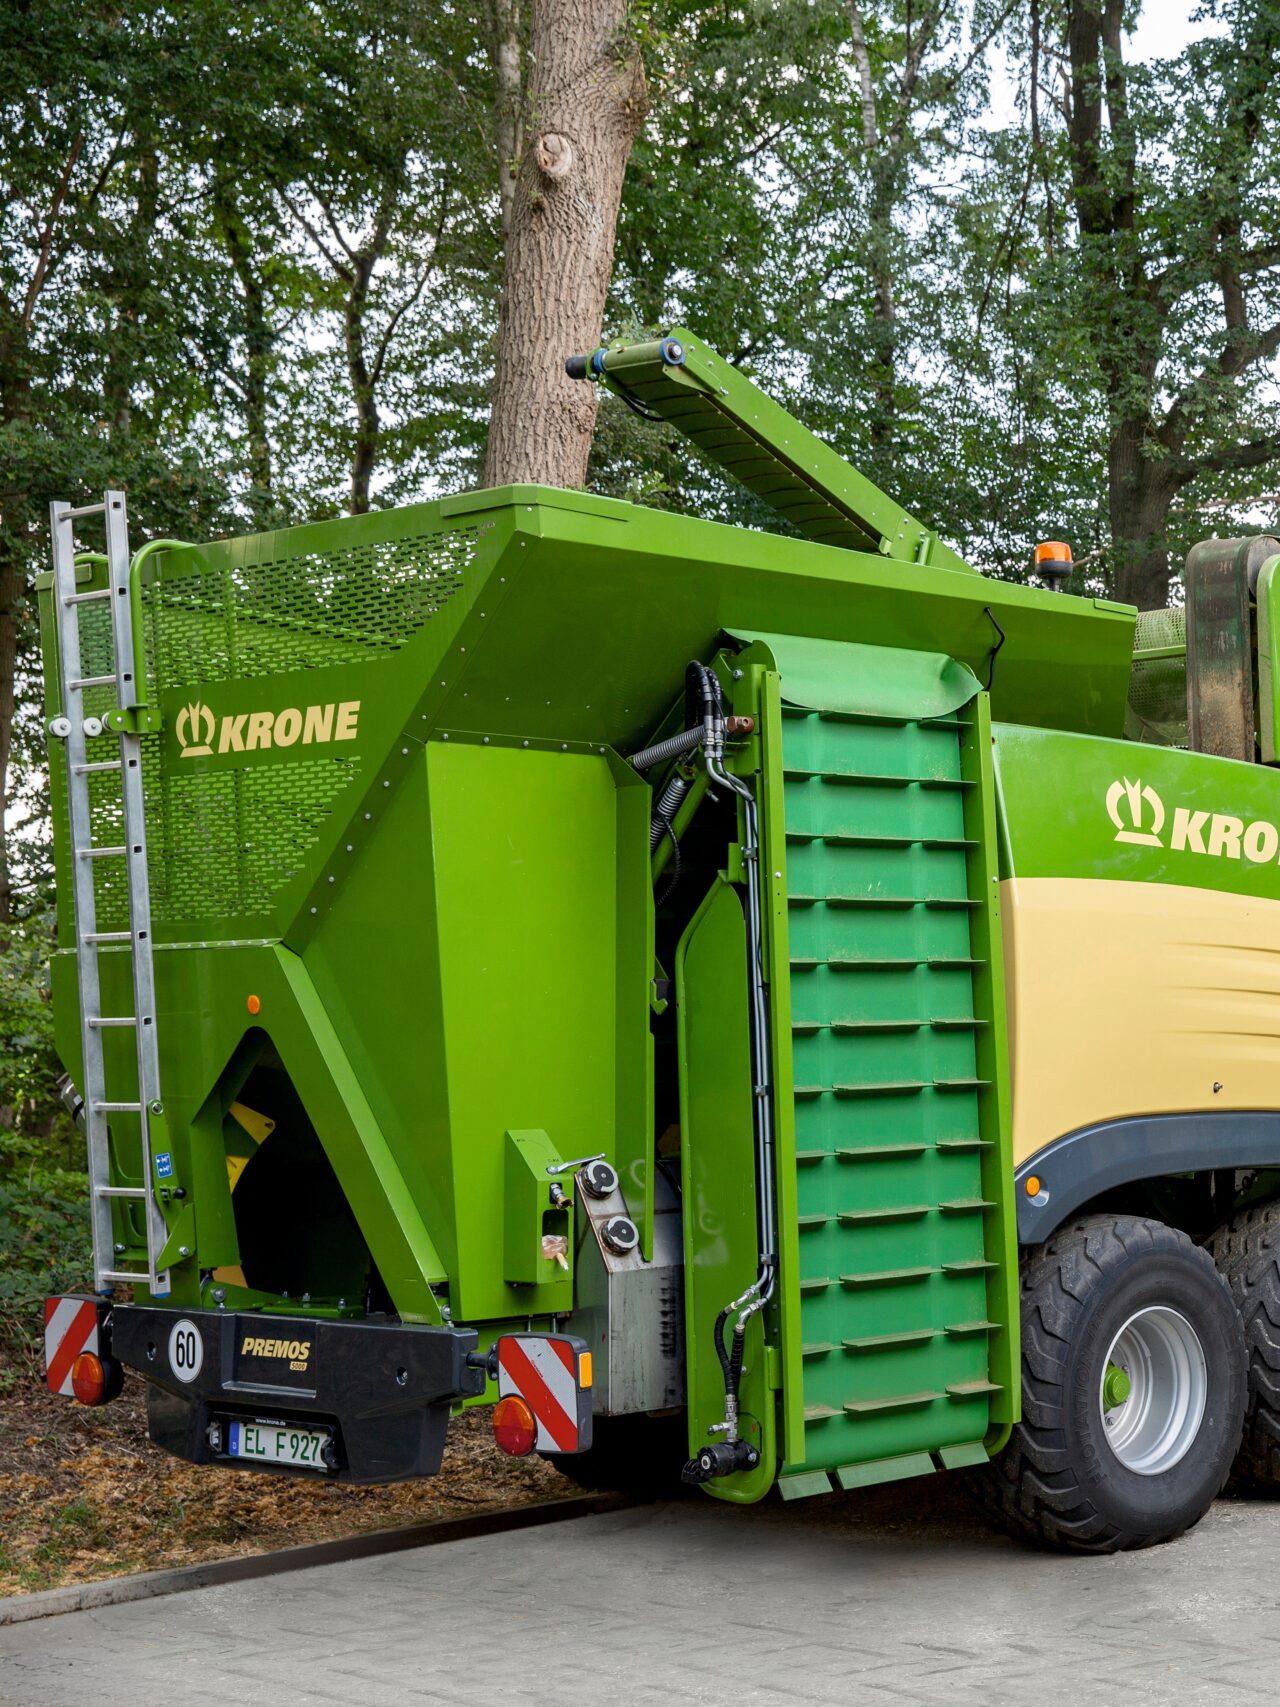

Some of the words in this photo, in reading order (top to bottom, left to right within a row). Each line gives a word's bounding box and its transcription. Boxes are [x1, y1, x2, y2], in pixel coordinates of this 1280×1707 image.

[218, 701, 361, 754] KRONE
[176, 1330, 196, 1369] 60
[241, 1337, 311, 1360] PREMOS
[291, 1362, 306, 1370] 5000
[255, 1418, 287, 1427] www.krone.de
[232, 1441, 238, 1450] D
[245, 1427, 265, 1455] EL
[276, 1431, 286, 1457] F
[290, 1433, 320, 1461] 927
